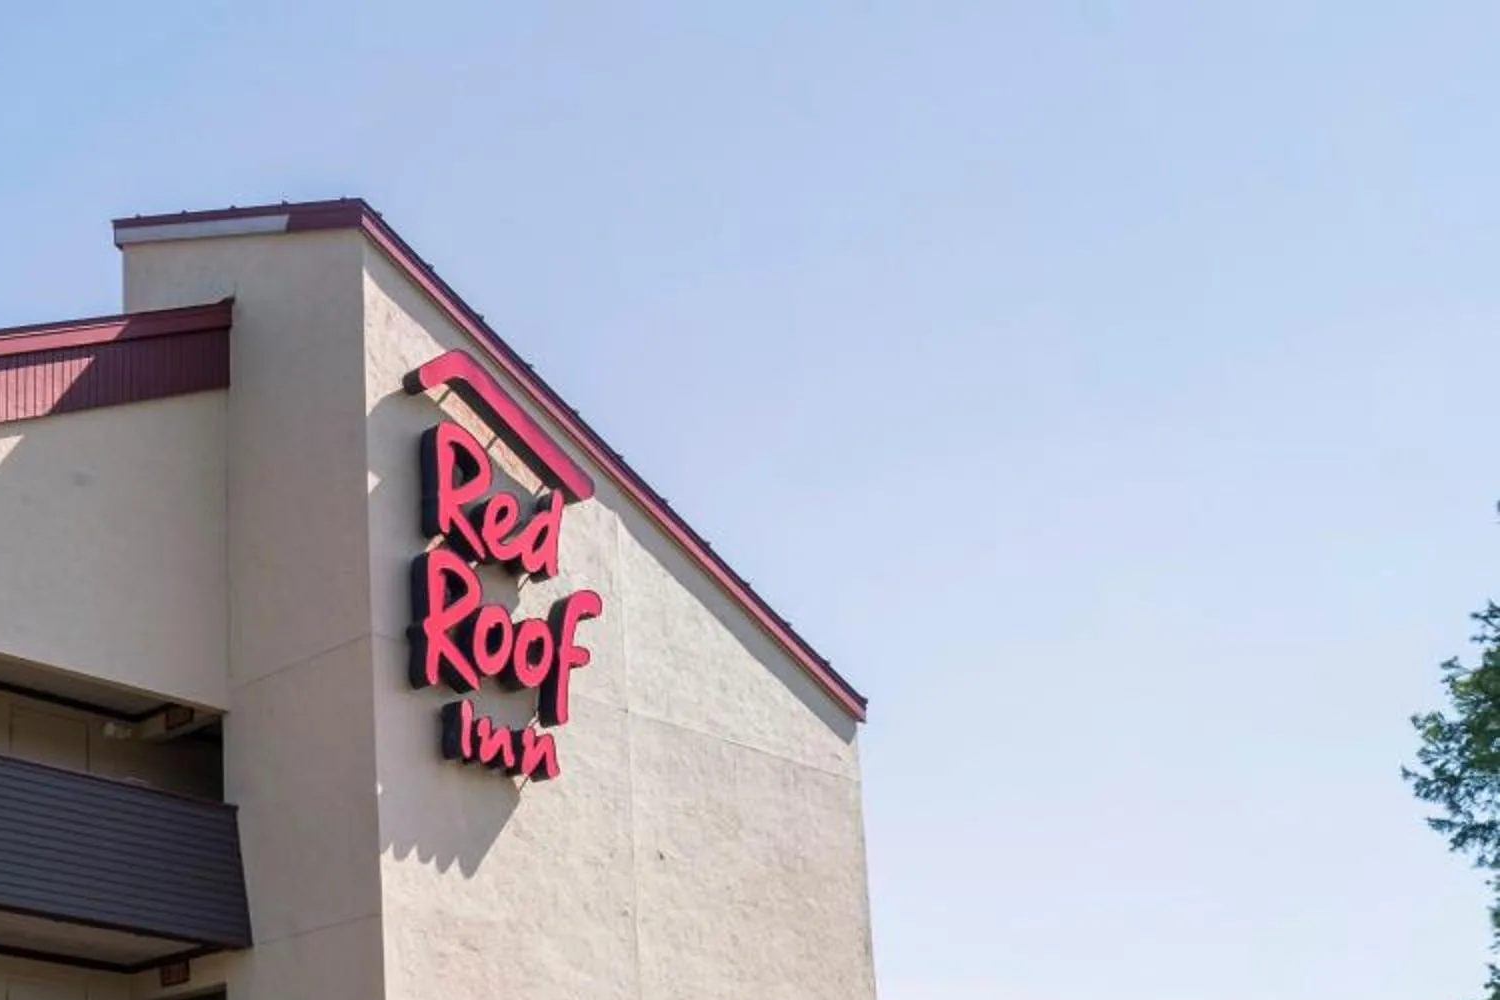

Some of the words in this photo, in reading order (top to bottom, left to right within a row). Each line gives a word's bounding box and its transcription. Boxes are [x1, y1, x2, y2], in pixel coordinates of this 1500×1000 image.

[434, 419, 564, 578] Red
[422, 548, 602, 726] Roof
[458, 699, 561, 779] Inn
